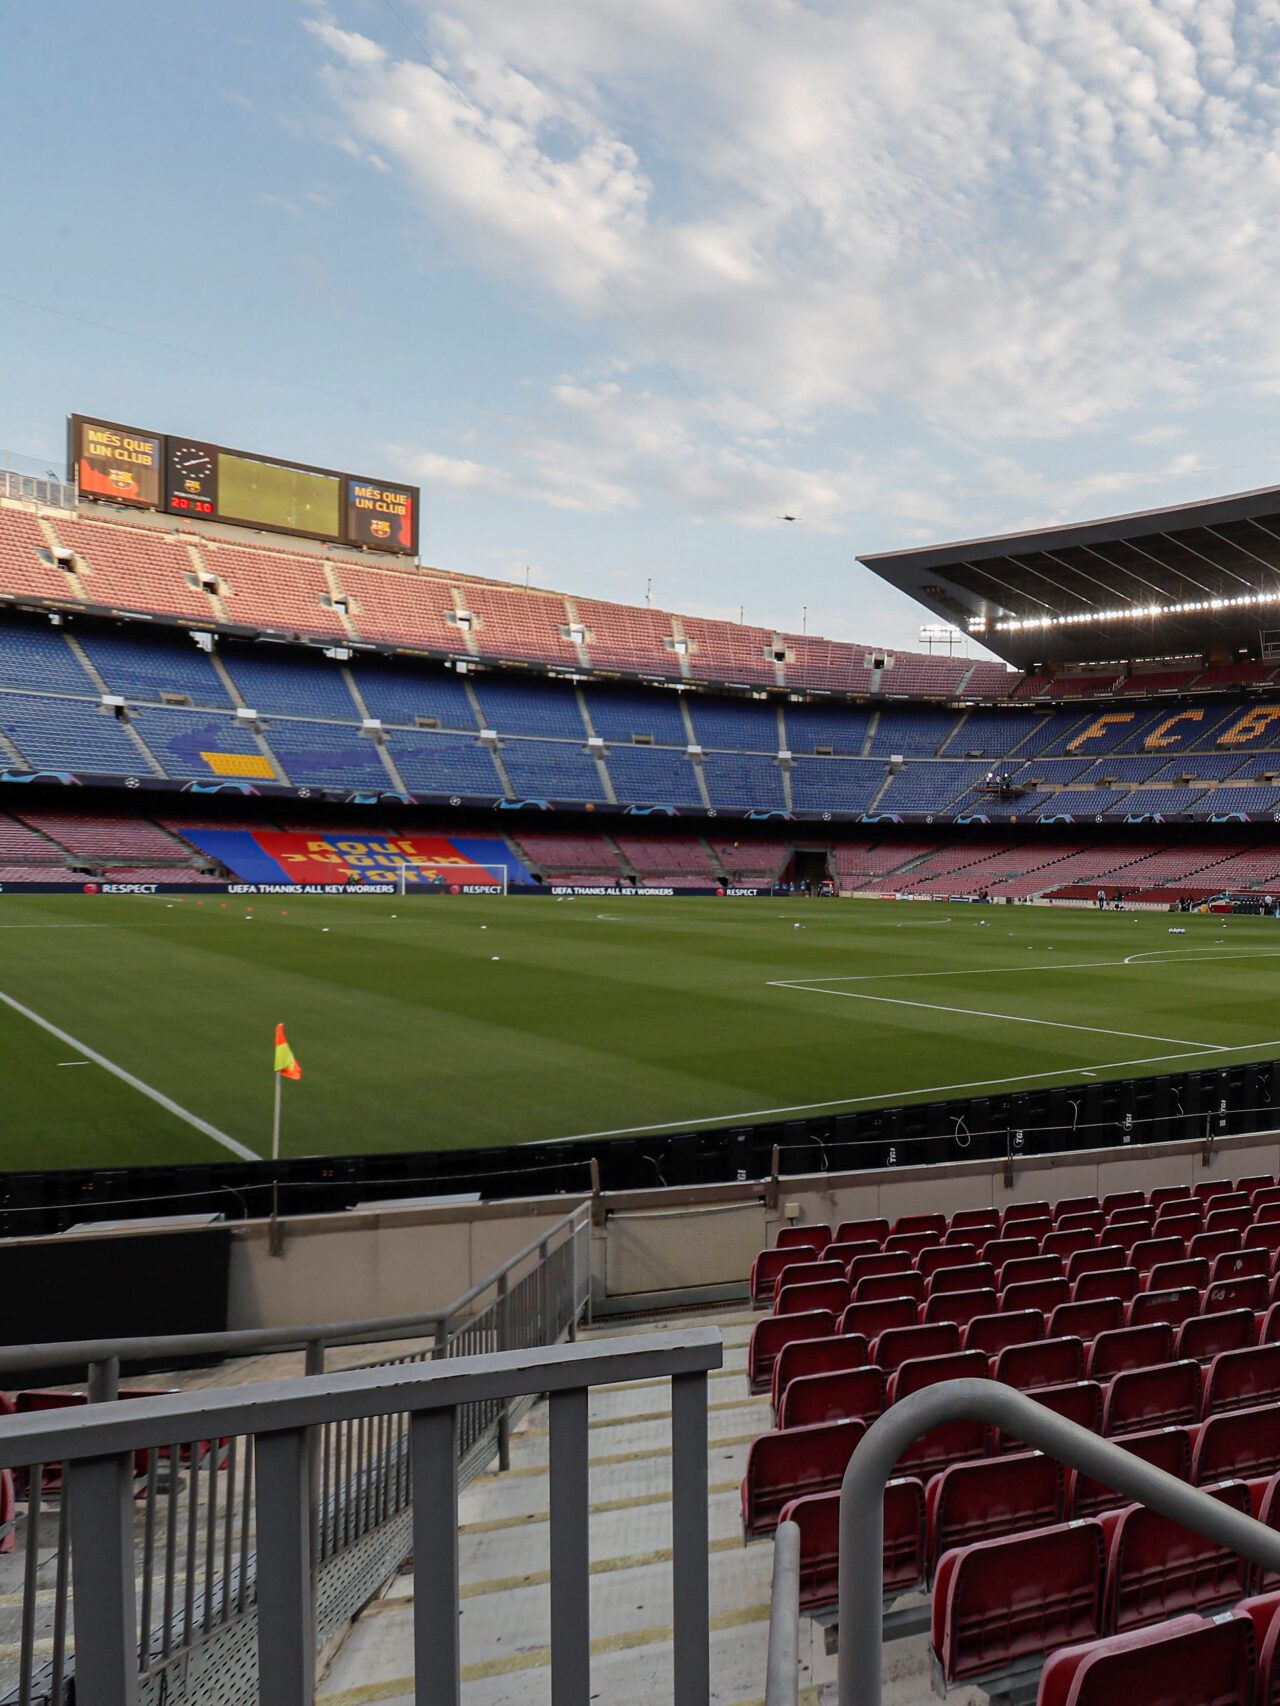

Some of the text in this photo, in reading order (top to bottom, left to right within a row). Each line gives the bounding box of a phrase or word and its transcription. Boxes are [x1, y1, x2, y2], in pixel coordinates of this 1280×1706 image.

[88, 430, 154, 454] MÉS QUE
[89, 444, 153, 465] UN CLUB
[354, 487, 408, 504] MÉS QUE
[356, 498, 407, 515] UN CLUB
[102, 884, 158, 893] RESPECT
[228, 884, 395, 894] UEFA THANKS ALL KEY WORKERS
[463, 886, 502, 894] RESPECT
[552, 887, 573, 895] UEFA
[573, 887, 606, 895] THANKS
[621, 888, 636, 896] KEY
[636, 888, 674, 896] WORKERS
